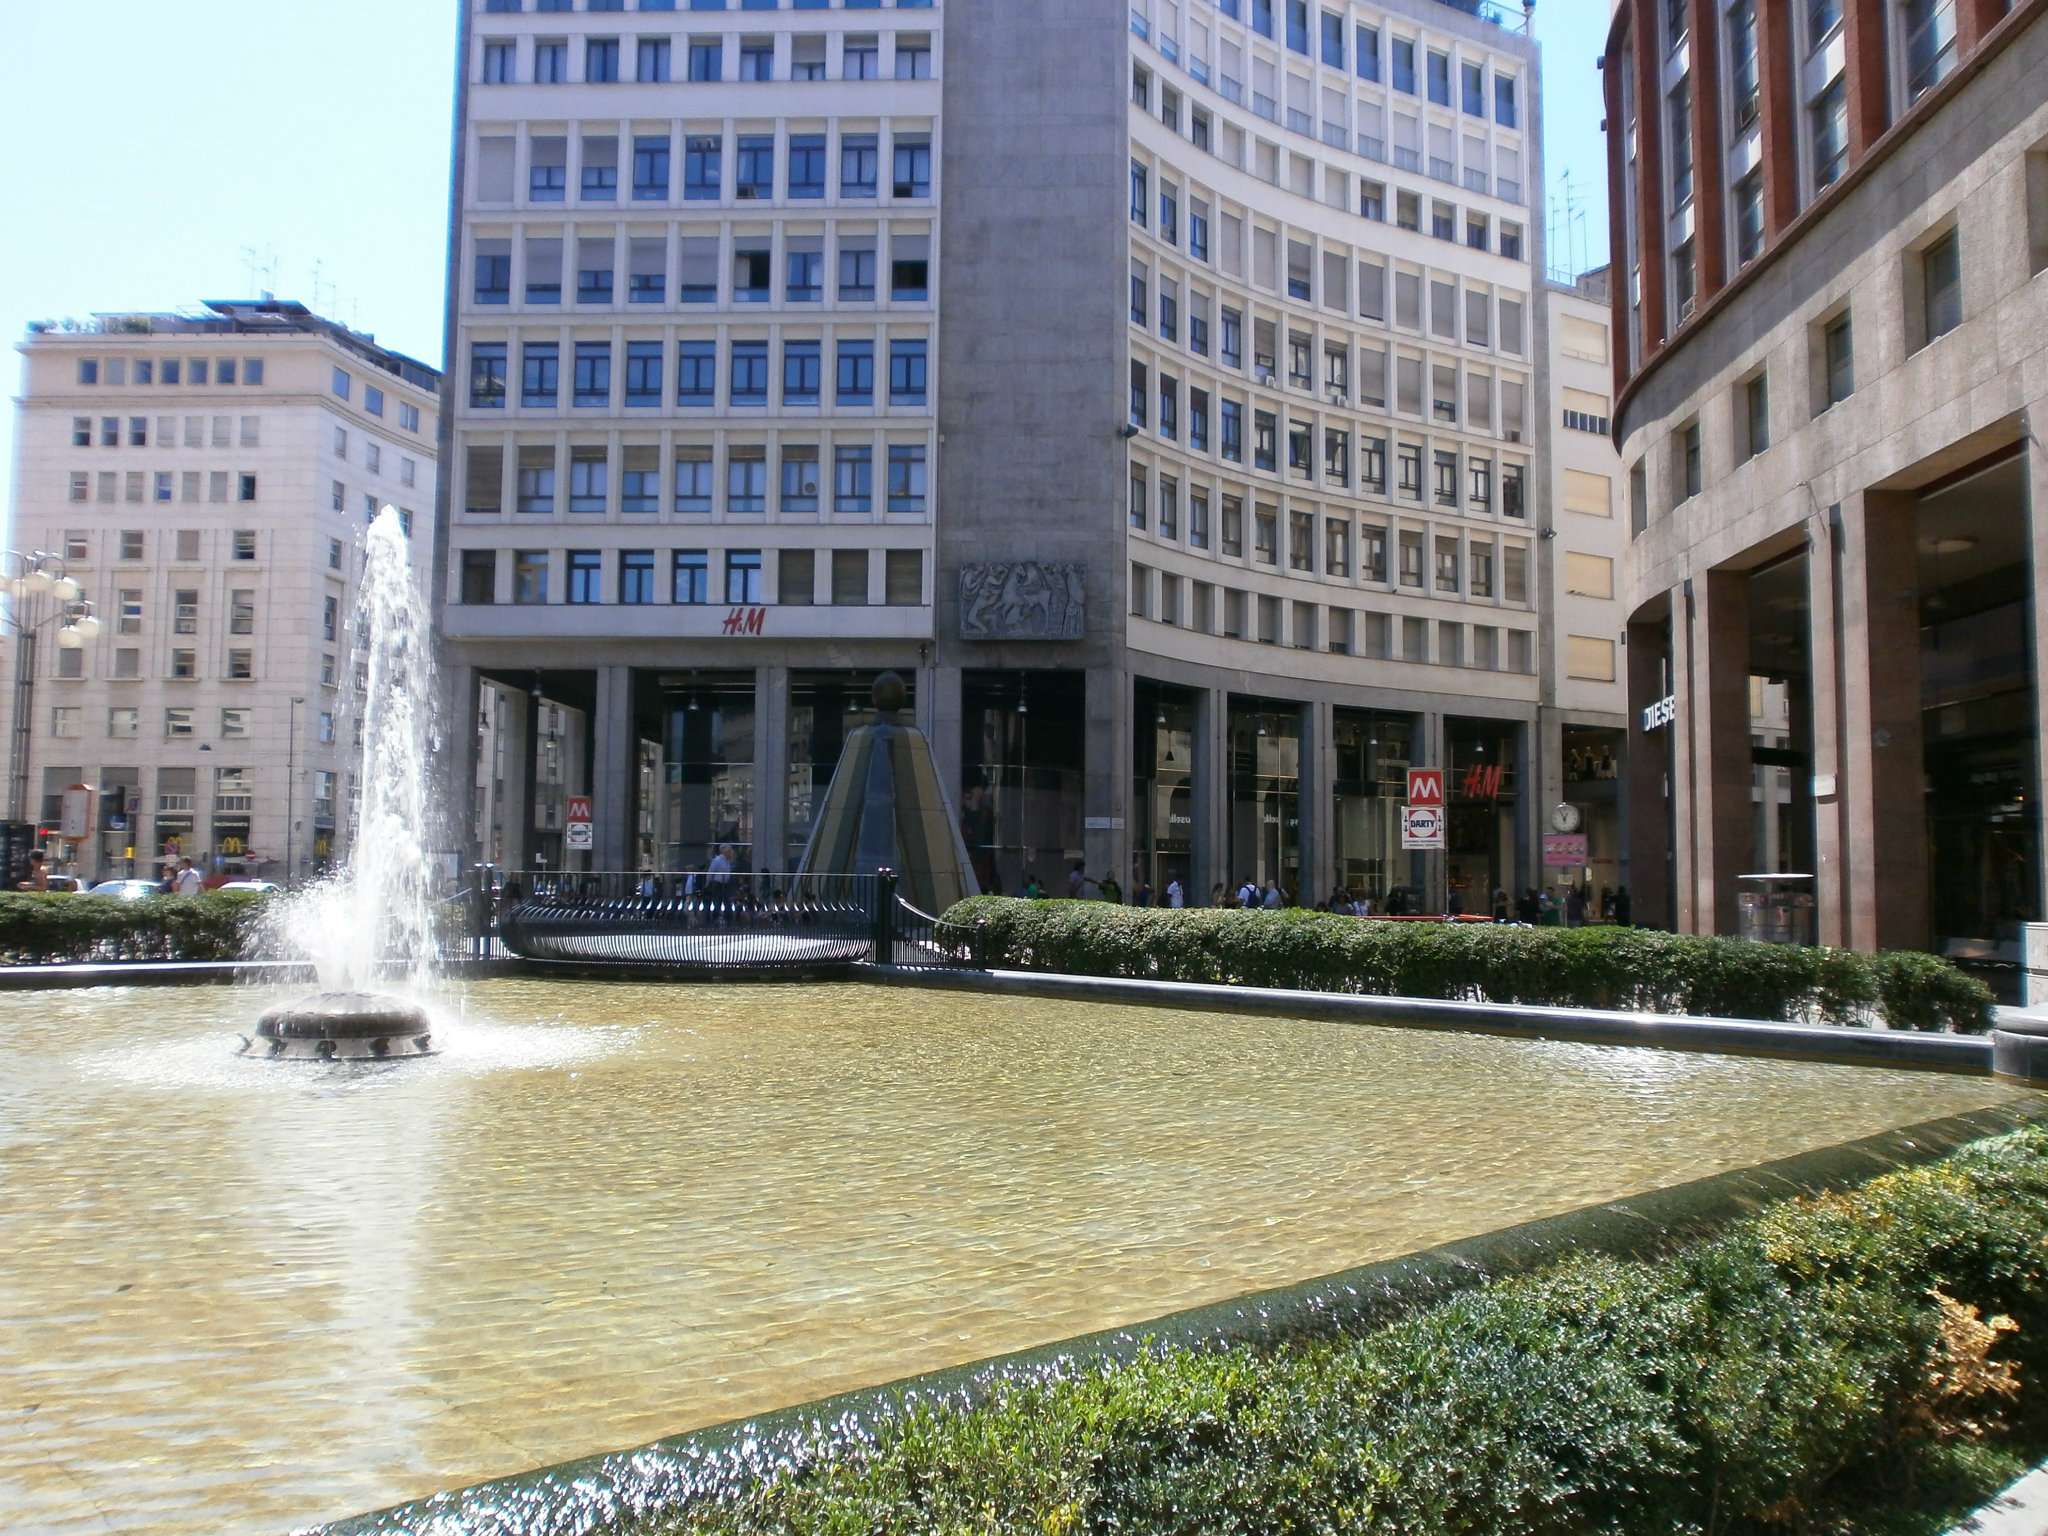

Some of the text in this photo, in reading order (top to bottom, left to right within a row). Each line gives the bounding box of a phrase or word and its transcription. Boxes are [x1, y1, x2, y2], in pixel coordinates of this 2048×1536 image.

[722, 608, 766, 635] H&M
[1411, 777, 1440, 798] M
[569, 802, 588, 816] M
